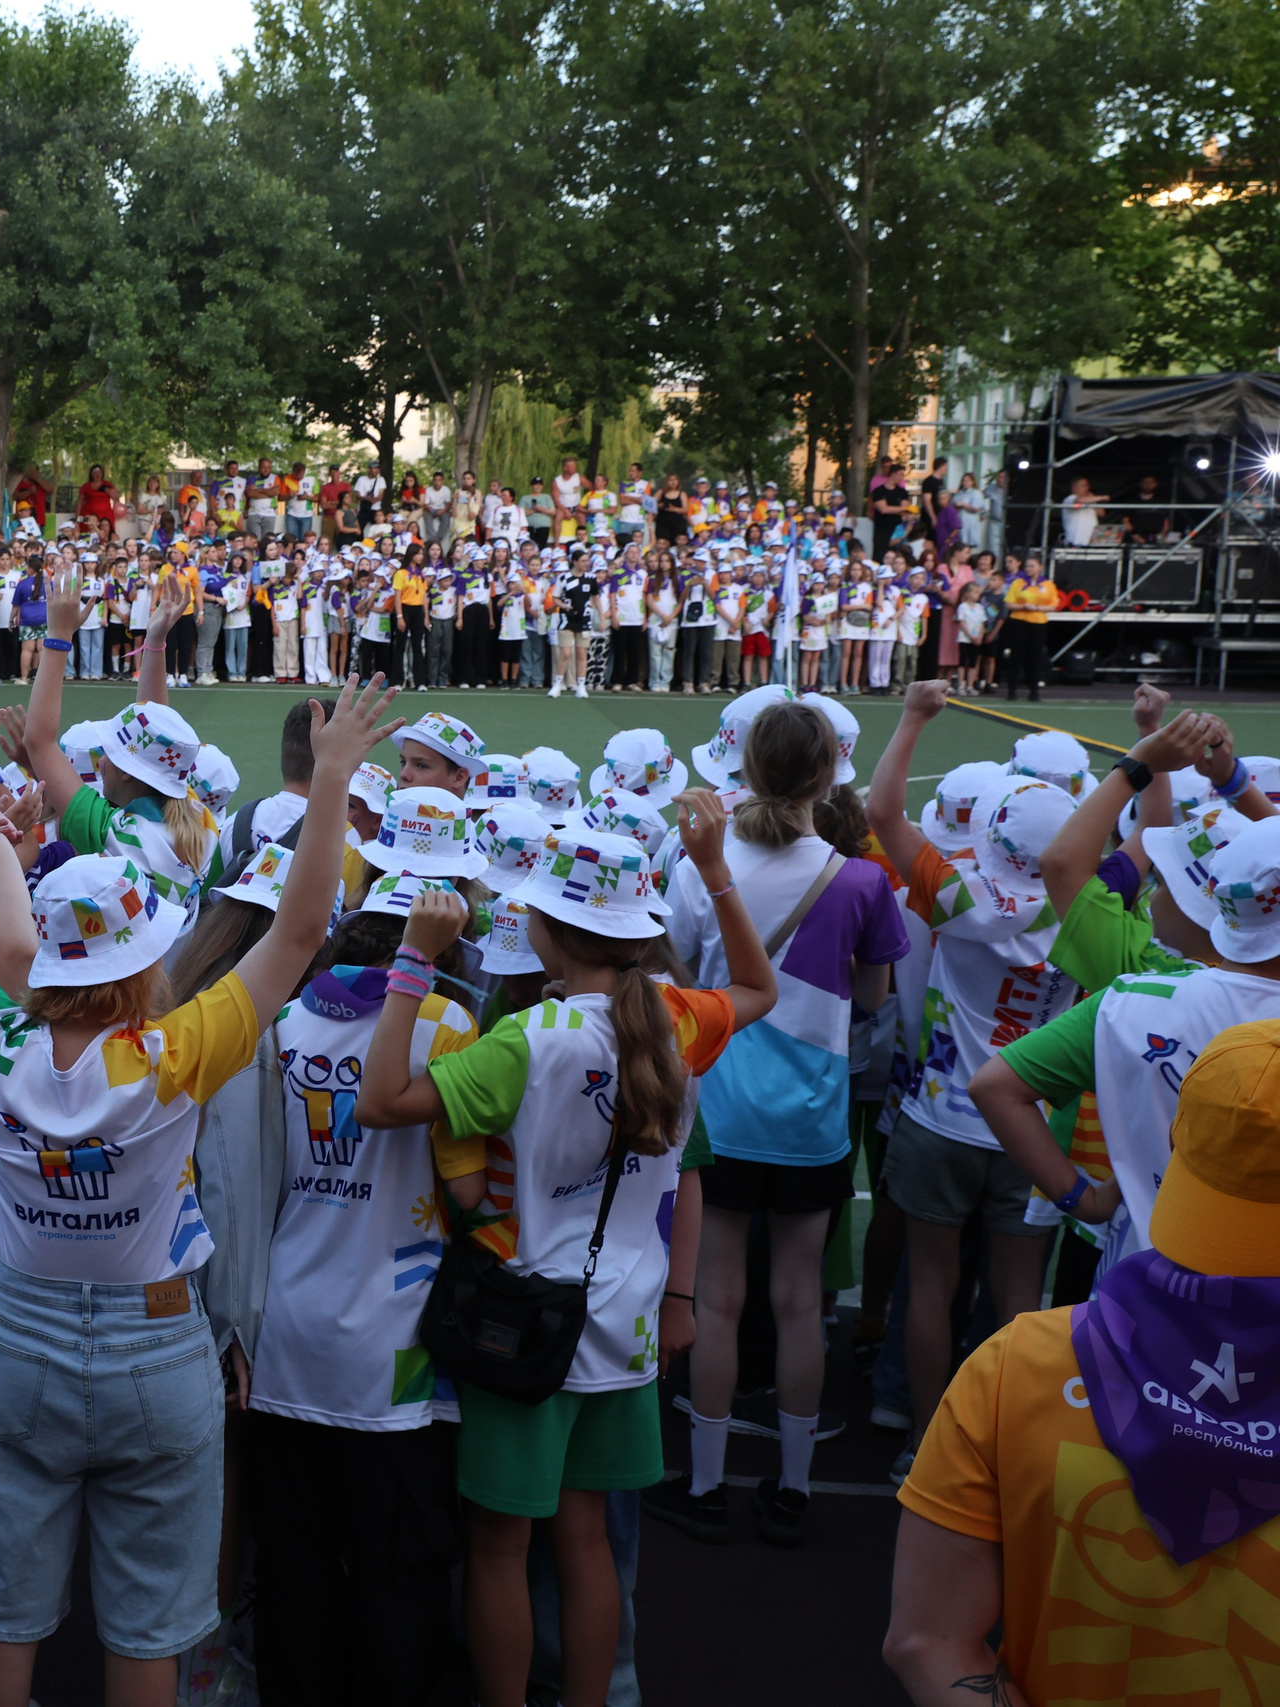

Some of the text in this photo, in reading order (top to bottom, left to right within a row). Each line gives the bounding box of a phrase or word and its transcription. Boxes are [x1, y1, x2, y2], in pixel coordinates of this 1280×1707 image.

[401, 819, 432, 833] ВИТА
[494, 914, 518, 928] ВИТА
[990, 961, 1046, 1047] ВИТА
[37, 1230, 116, 1241] страна детства
[1142, 1381, 1280, 1444] аврор
[1173, 1423, 1274, 1458] республика
